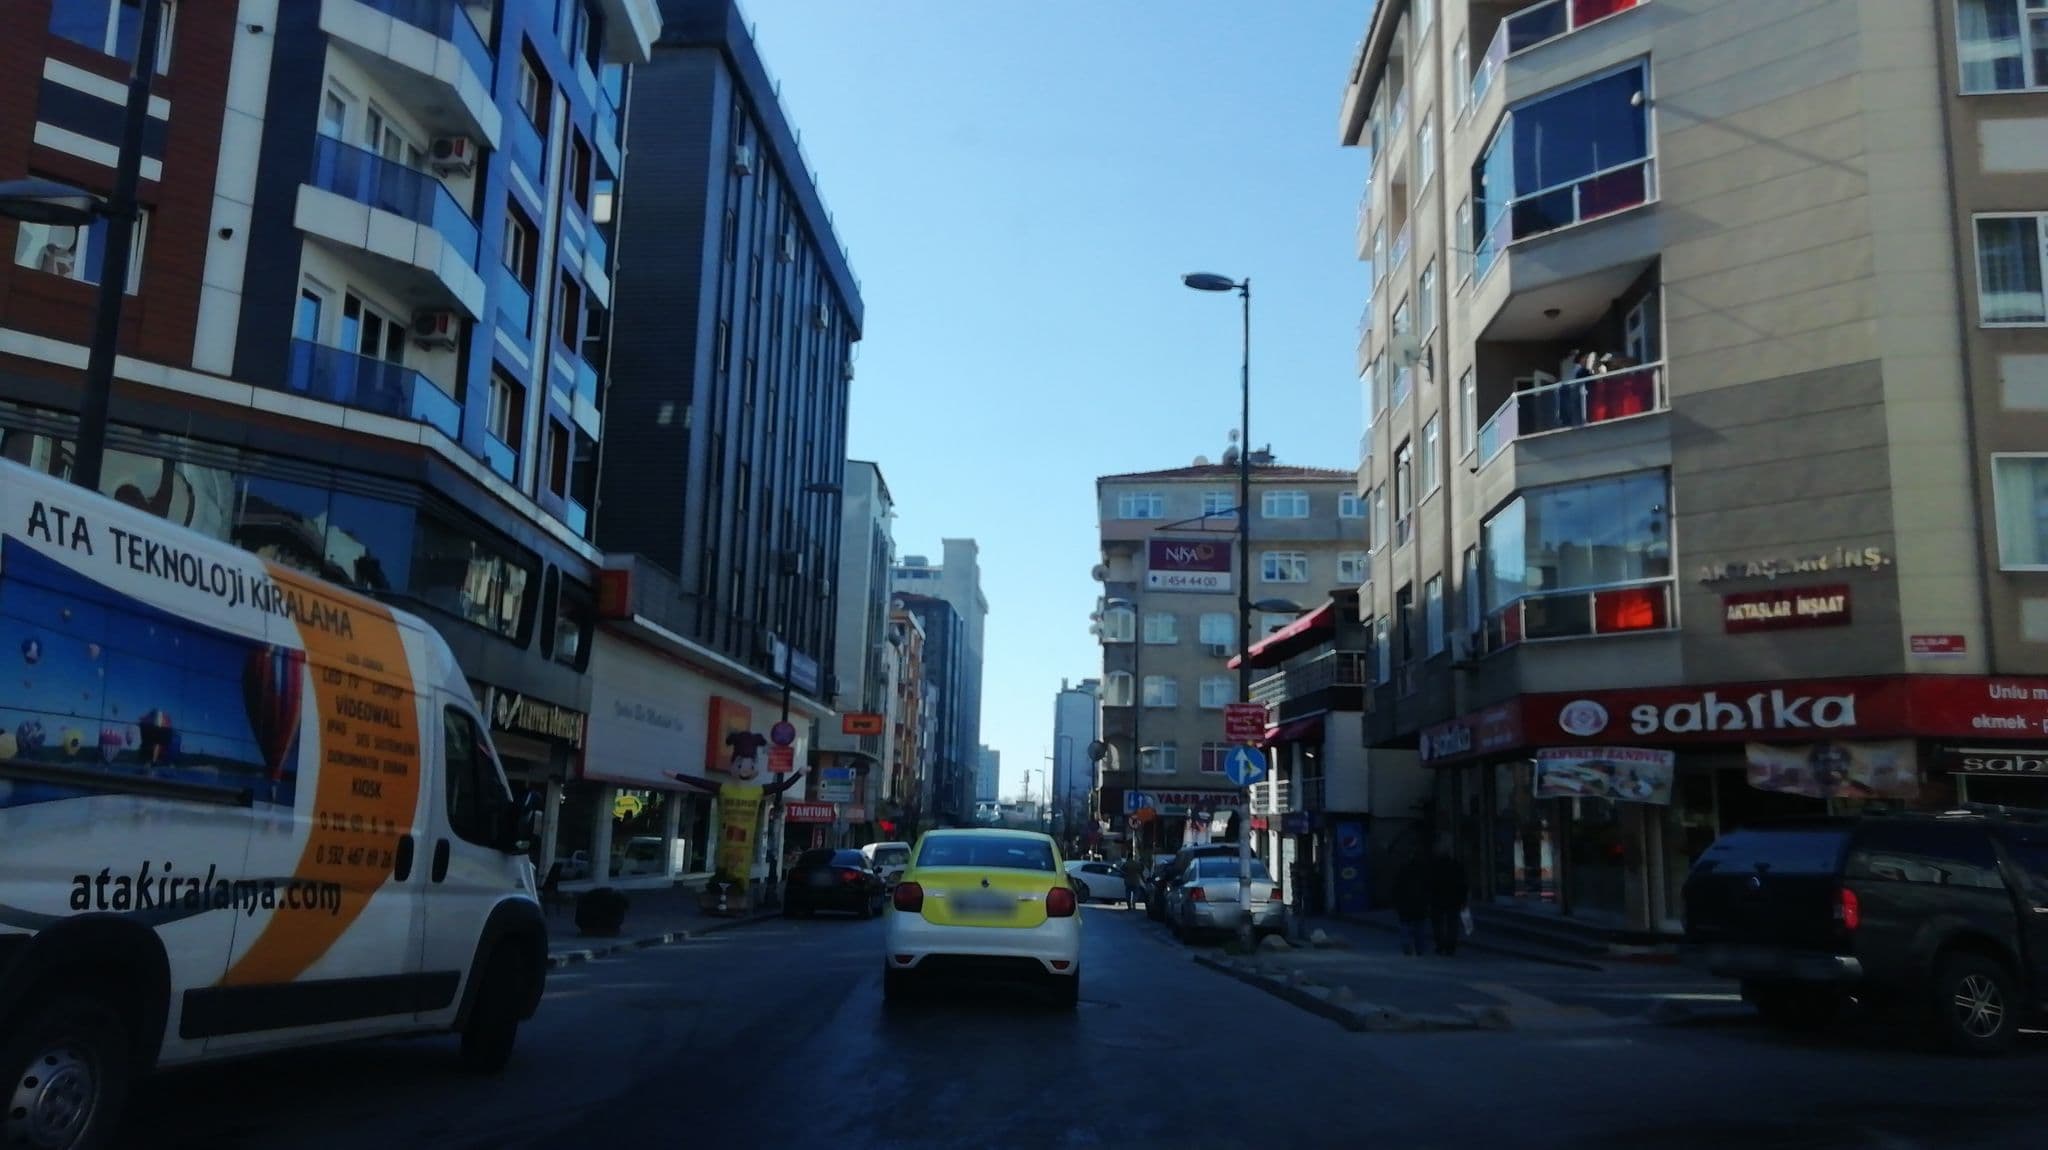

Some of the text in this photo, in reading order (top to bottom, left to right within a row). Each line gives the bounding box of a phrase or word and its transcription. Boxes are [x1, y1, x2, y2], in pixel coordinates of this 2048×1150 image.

[27, 501, 93, 555] ATA
[1971, 714, 2028, 729] ekmek
[316, 845, 324, 865] 0
[70, 861, 341, 917] atakiralama.com
